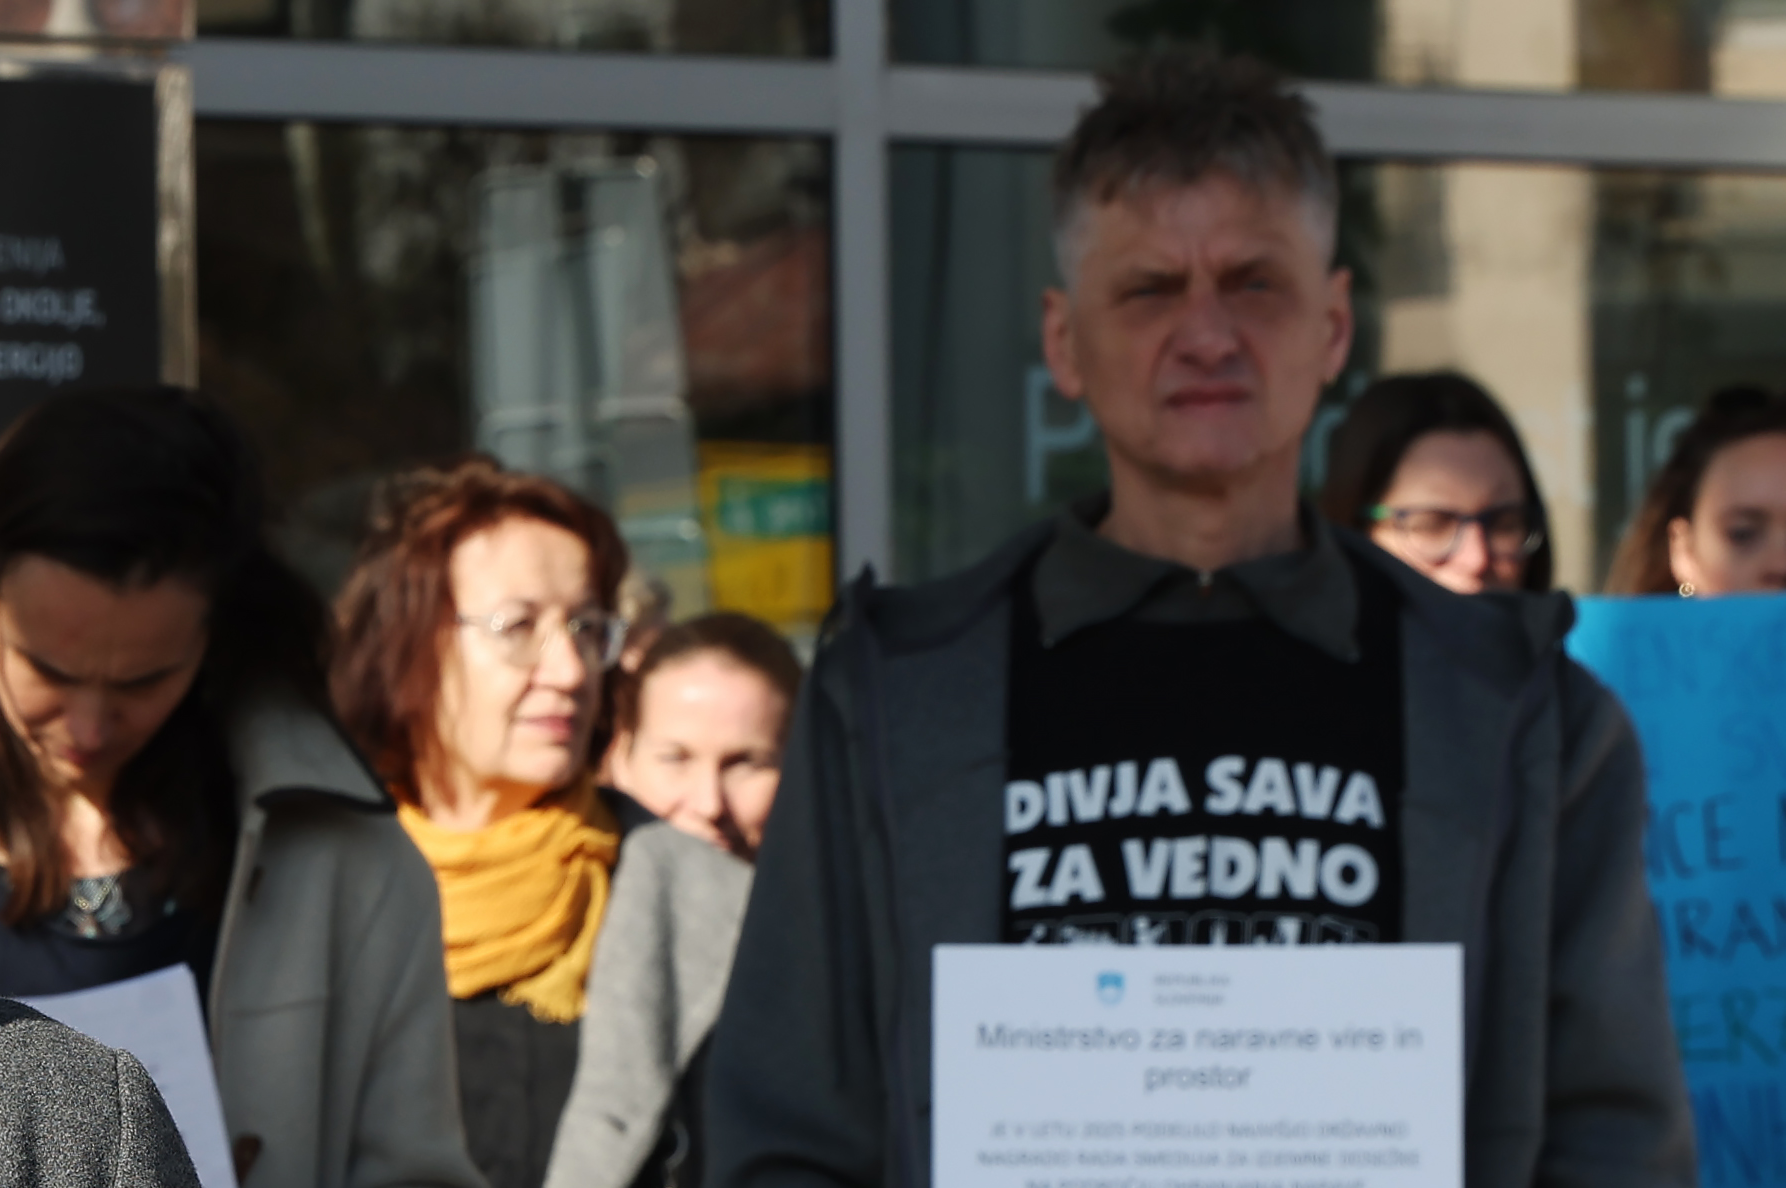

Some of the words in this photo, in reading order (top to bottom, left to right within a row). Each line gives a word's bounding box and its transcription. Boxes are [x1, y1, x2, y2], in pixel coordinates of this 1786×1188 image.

[0, 288, 105, 330] OKOLJE,
[1005, 757, 1192, 835] DIVJA
[1204, 755, 1384, 828] SAVA
[1008, 845, 1106, 910] ZA
[1120, 835, 1379, 907] VEDNO
[977, 1023, 1140, 1051] Ministrstvo
[1149, 1027, 1187, 1051] za
[1194, 1027, 1319, 1051] naravne
[1329, 1021, 1386, 1051] vire
[1393, 1021, 1423, 1051] in
[1144, 1063, 1252, 1093] prostor
